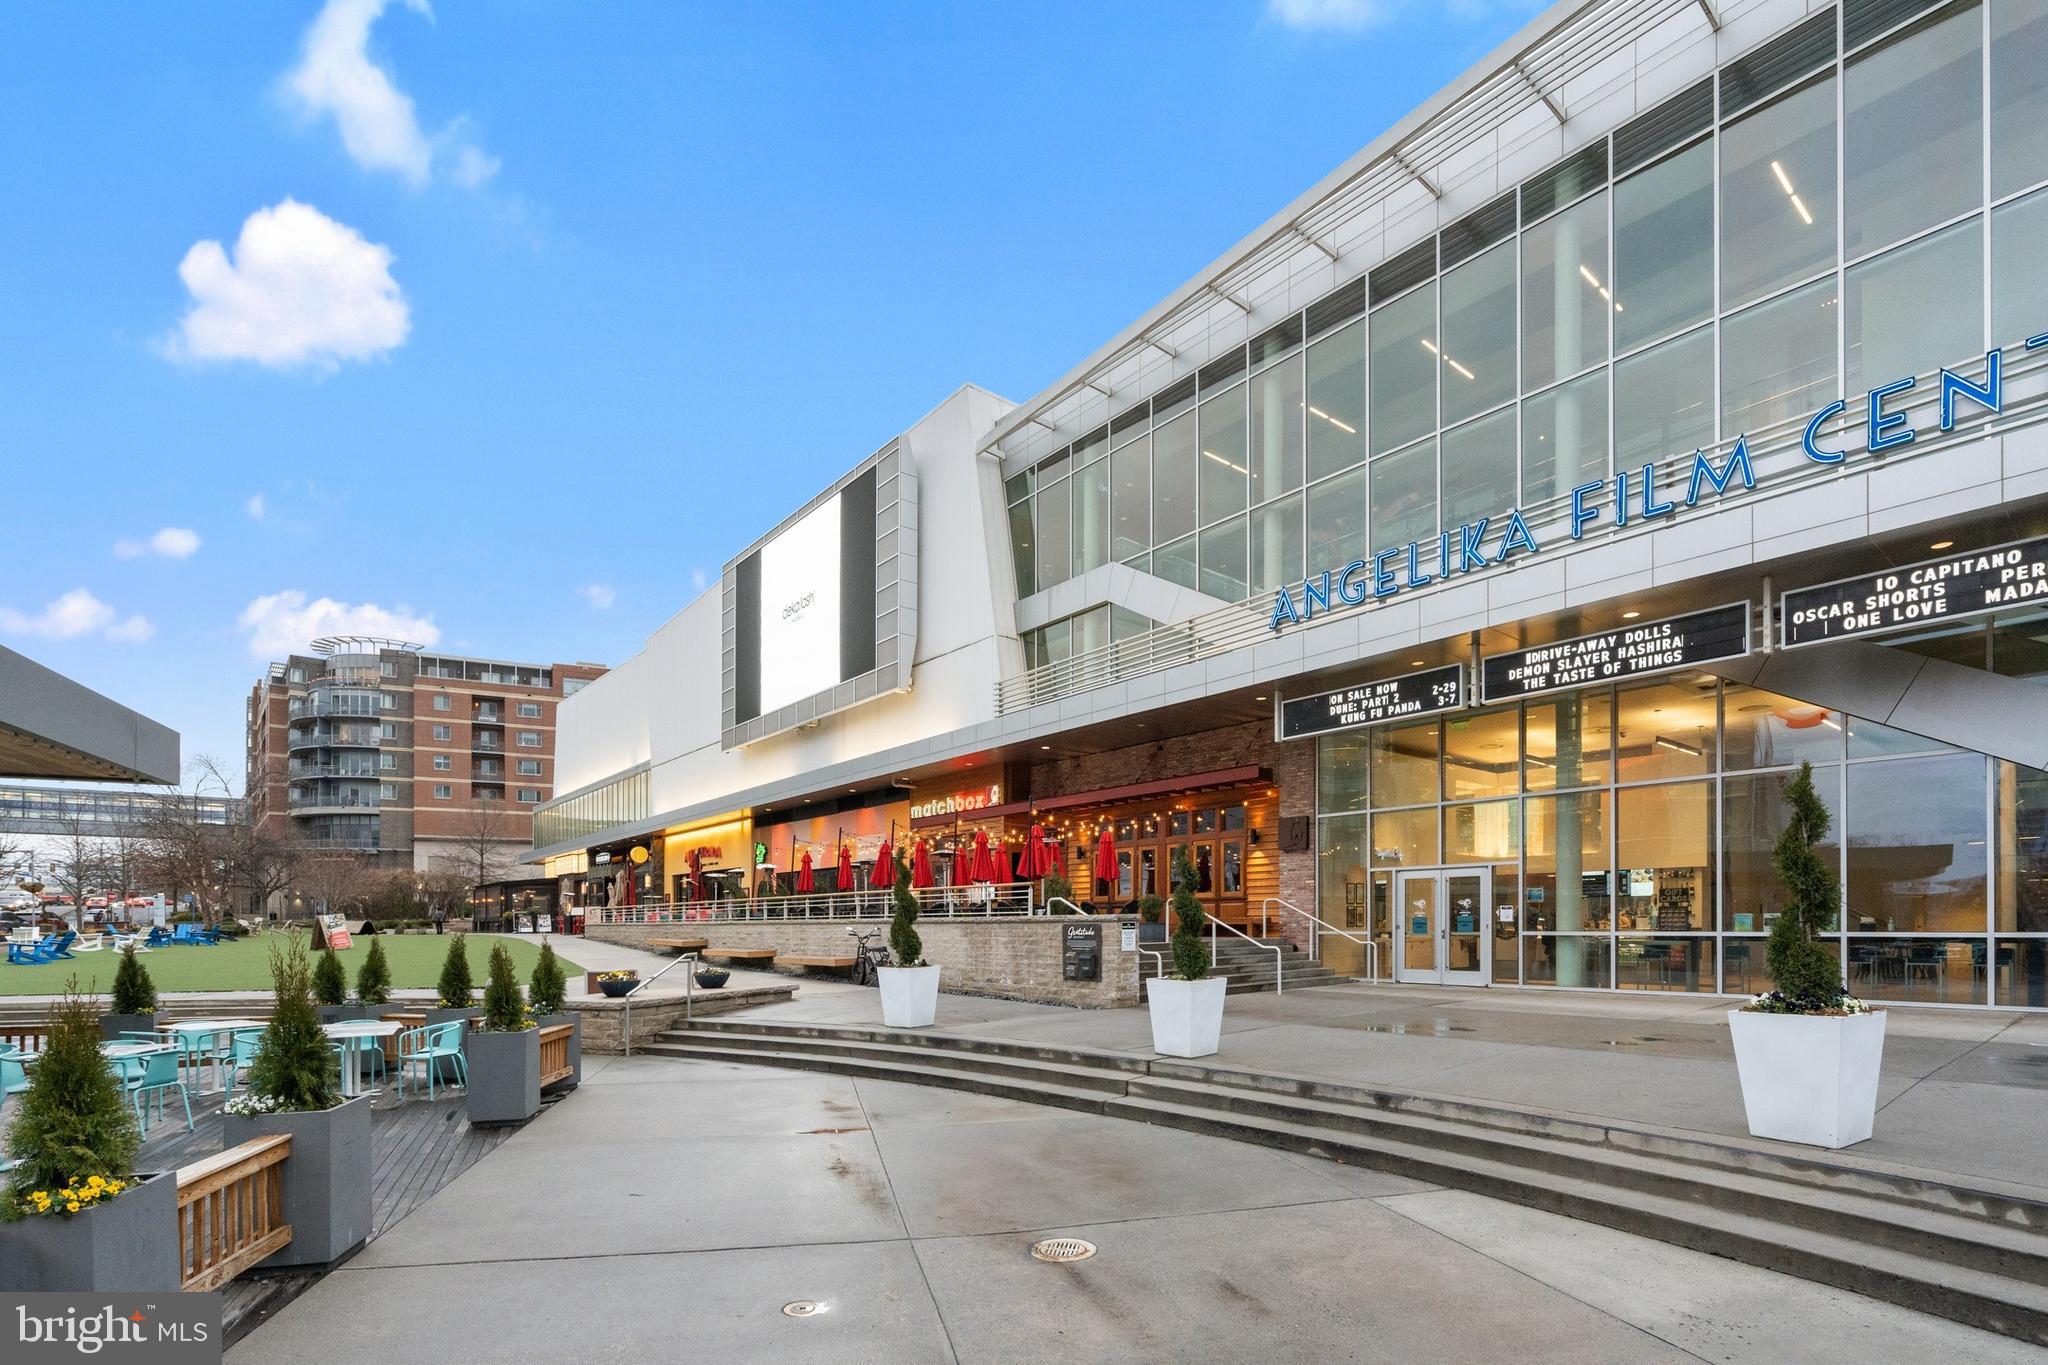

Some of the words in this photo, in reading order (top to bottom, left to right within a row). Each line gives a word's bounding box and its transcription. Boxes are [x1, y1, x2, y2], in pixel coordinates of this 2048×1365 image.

[1268, 507, 1540, 629] ANGELIKA
[1571, 432, 1756, 541] FILM
[1910, 549, 2022, 585] CAPITANO
[2001, 562, 2047, 584] PER
[1792, 601, 1855, 625] OSCAR
[1865, 582, 1946, 611] SHORTS
[1985, 578, 2048, 604] MADA
[1843, 611, 1881, 631] ONE
[1893, 599, 1947, 622] LOVE
[1625, 624, 1672, 644] DOLLS
[1508, 662, 1550, 681] DEMON
[1557, 650, 1610, 671] SLAYER
[1617, 637, 1681, 659] HASHIRA
[1522, 677, 1546, 691] THE
[1553, 669, 1595, 685] TASTE
[1603, 661, 1622, 675] OF
[1630, 649, 1682, 671] THINGS
[1330, 694, 1342, 706] ON
[1347, 689, 1372, 701] SALE
[1376, 681, 1399, 696] NOW
[1432, 681, 1457, 696] 2-29
[1437, 694, 1456, 707] 3-7
[1329, 702, 1358, 716] DUNE:
[1361, 695, 1387, 711] PART
[1393, 693, 1400, 704] 2
[1340, 710, 1366, 725] KUNG
[1370, 708, 1383, 720] FU
[1388, 700, 1422, 716] PANDA
[910, 795, 985, 819] matchbox
